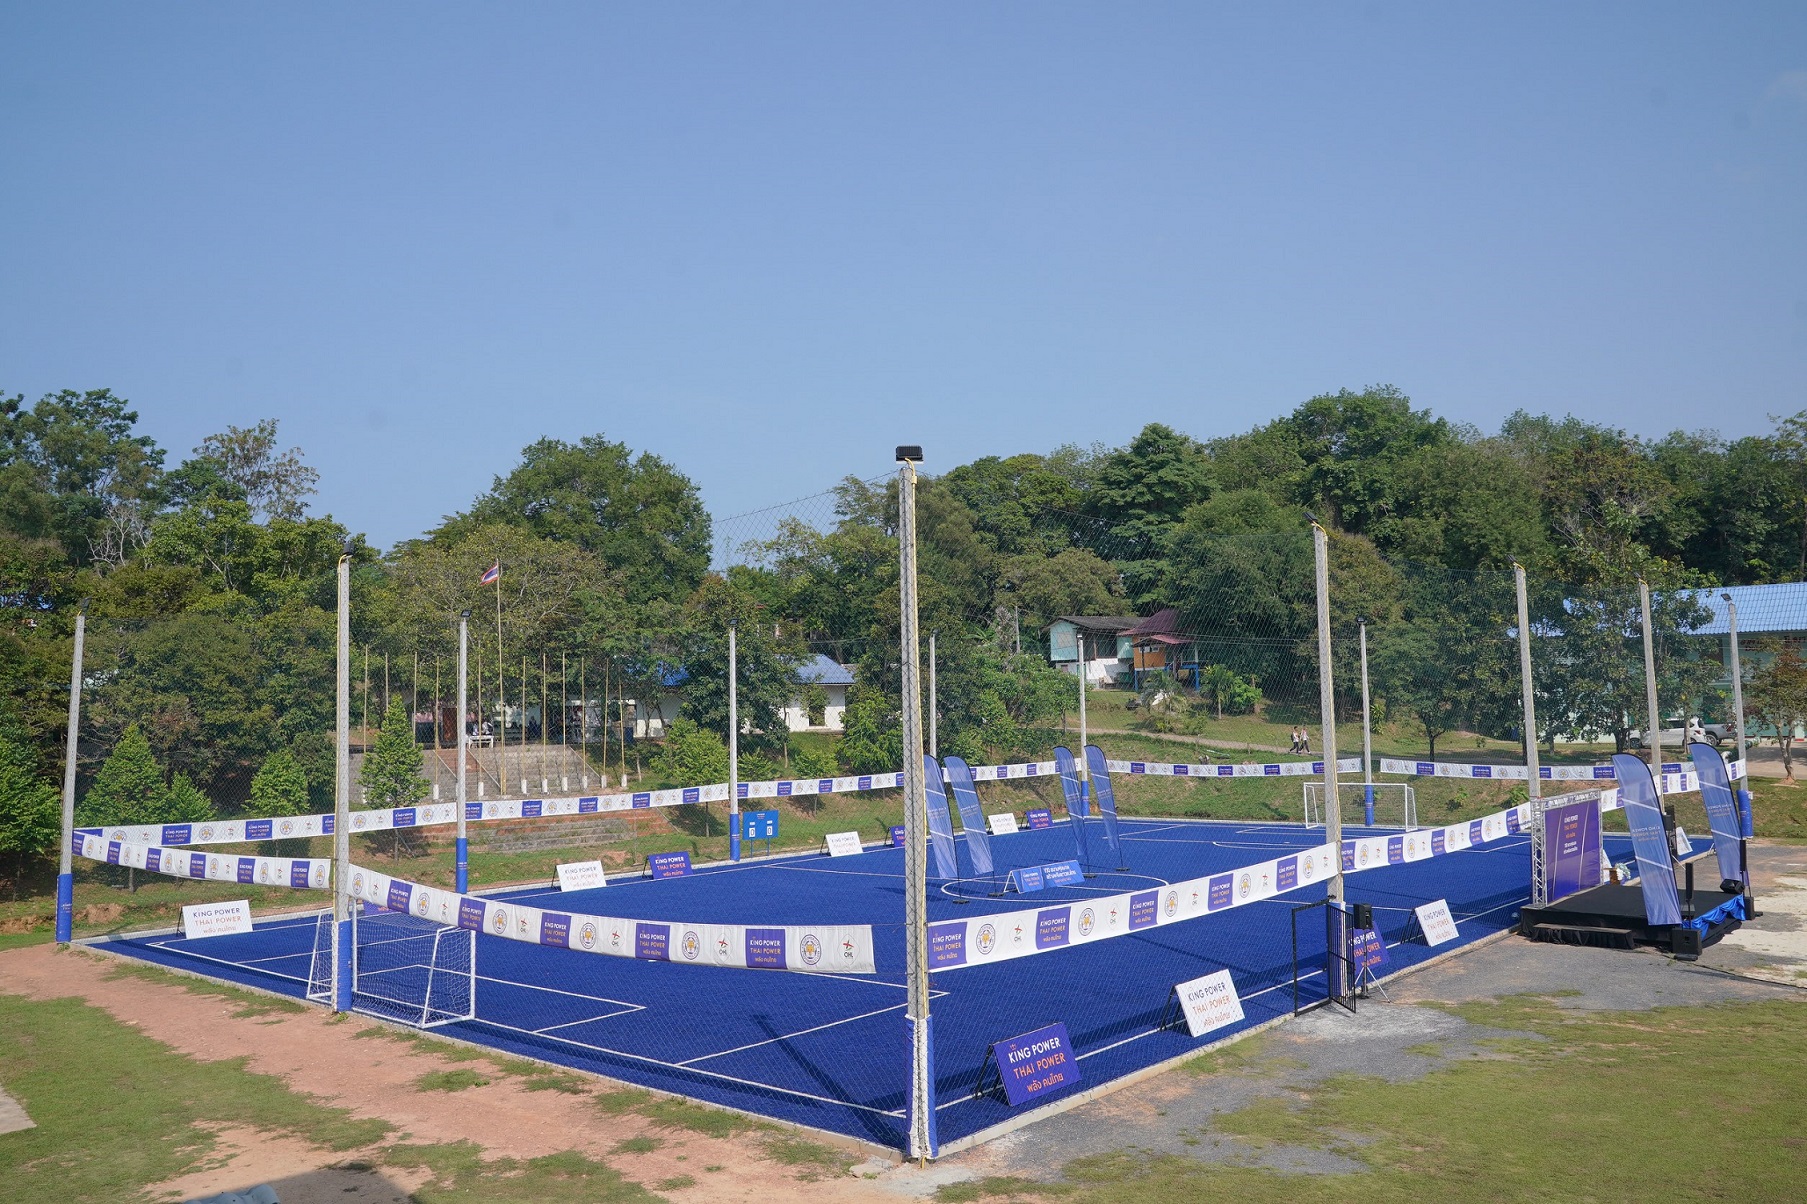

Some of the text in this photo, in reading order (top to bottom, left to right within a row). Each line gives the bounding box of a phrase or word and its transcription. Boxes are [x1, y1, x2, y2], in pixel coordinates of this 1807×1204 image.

[932, 935, 944, 943] KING
[1188, 982, 1226, 1002] KING POWER
[1192, 995, 1231, 1015] THAI POWER
[1008, 1037, 1061, 1064] KING POWER
[1013, 1052, 1066, 1079] THAI POWER
[1026, 1072, 1064, 1093] พลัง คนไทย
